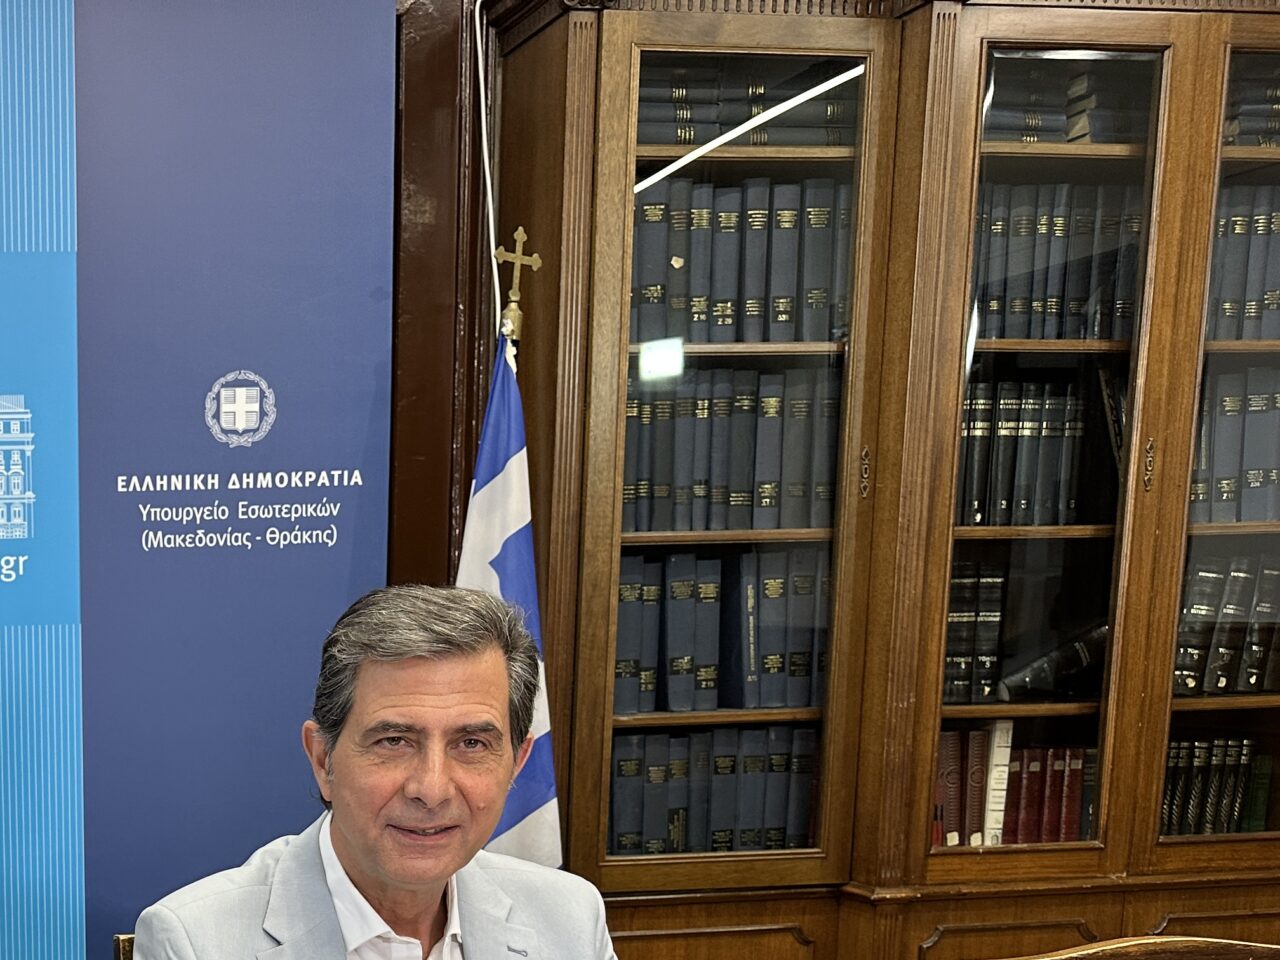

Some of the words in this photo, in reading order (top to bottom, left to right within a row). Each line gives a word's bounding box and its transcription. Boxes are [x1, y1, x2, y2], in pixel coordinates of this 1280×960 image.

[117, 473, 219, 493] ΕΛΛΗΝΙΚΗ
[228, 469, 363, 489] ΔΗΜΟΚΡΑΤΙΑ
[139, 500, 229, 524] Υπουργείο
[238, 497, 341, 522] Εσωτερικών
[141, 527, 252, 551] (Μακεδονίας
[266, 524, 338, 548] Θράκης)
